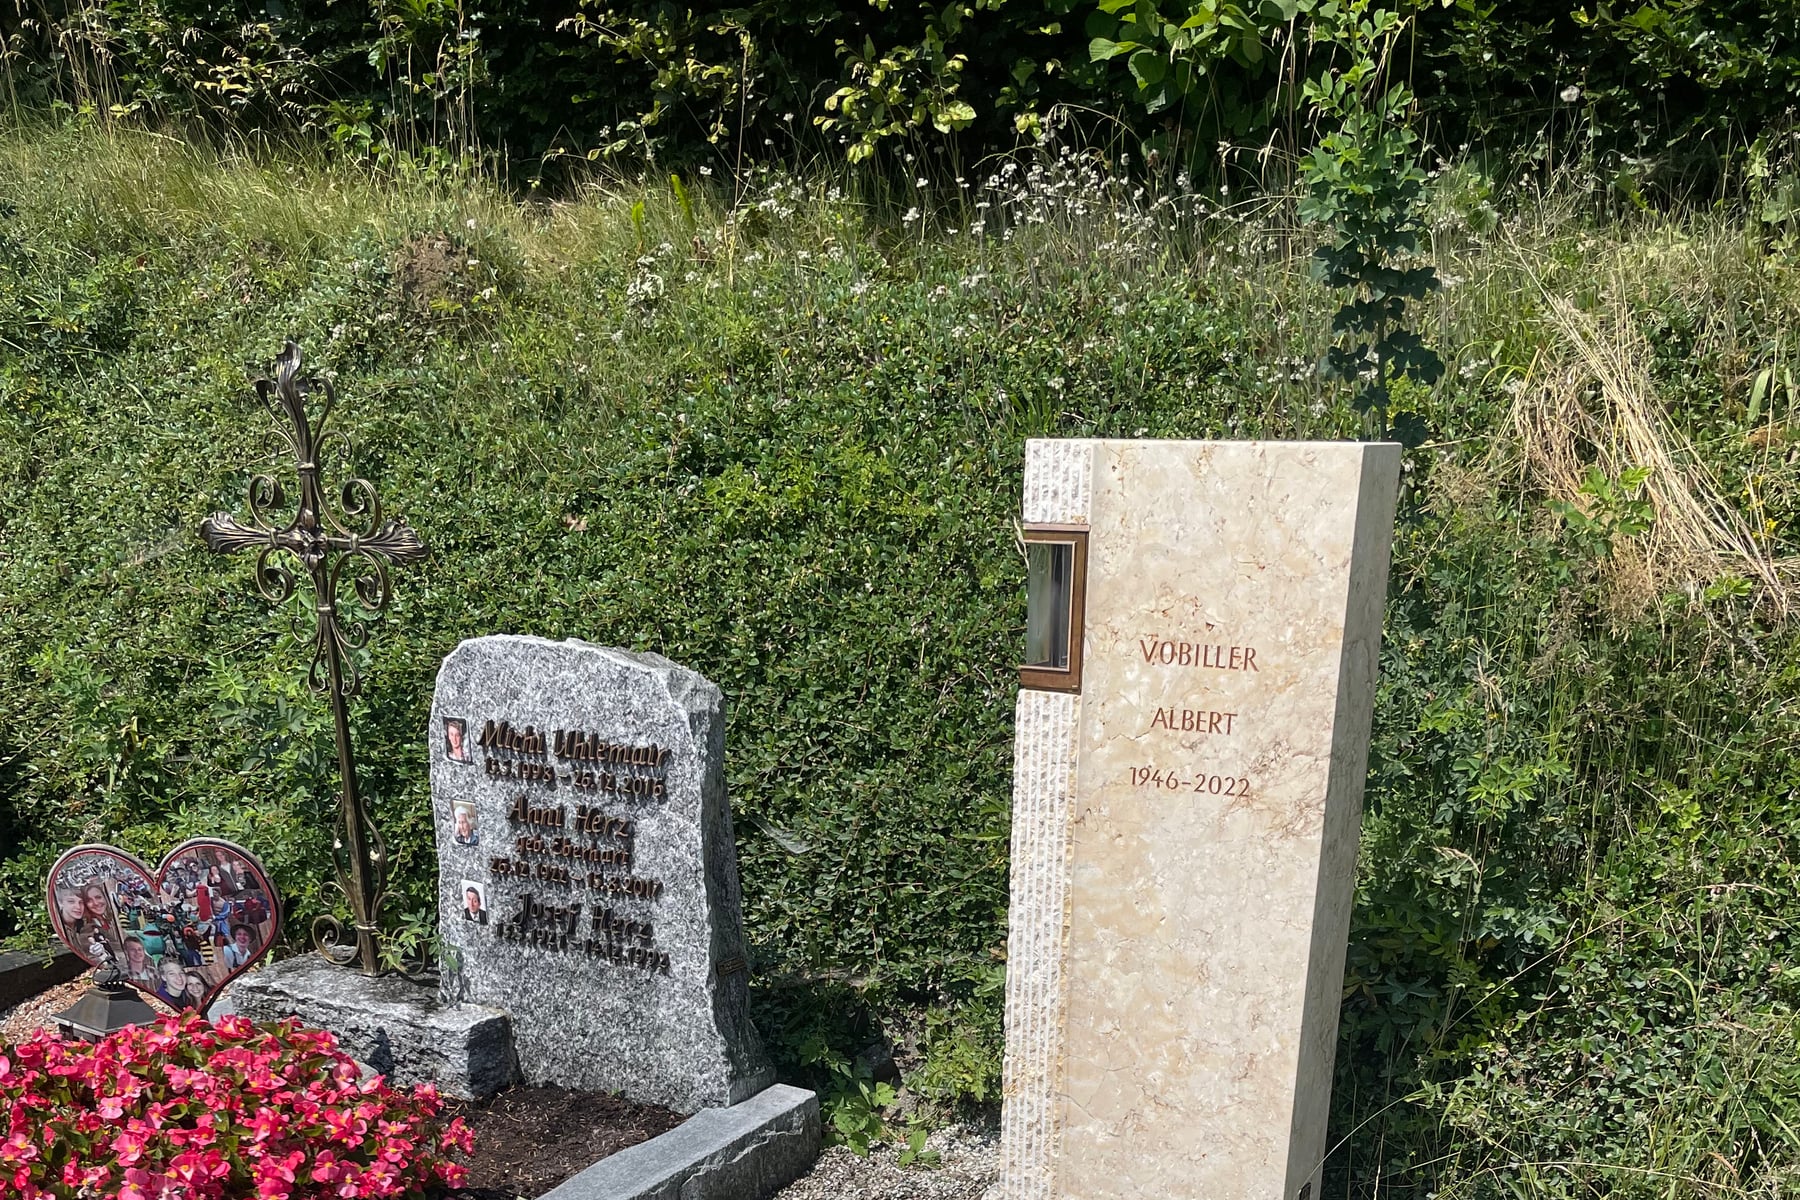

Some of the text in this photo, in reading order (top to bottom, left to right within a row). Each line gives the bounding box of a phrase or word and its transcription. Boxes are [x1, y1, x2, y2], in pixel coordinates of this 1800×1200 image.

[1140, 639, 1260, 672] VOBILLER
[479, 719, 547, 754] Michi
[1151, 706, 1238, 735] ALBERT
[1129, 766, 1250, 797] 1946-2022
[508, 793, 632, 838] Anni Herz
[512, 893, 655, 940] Josef Herz
